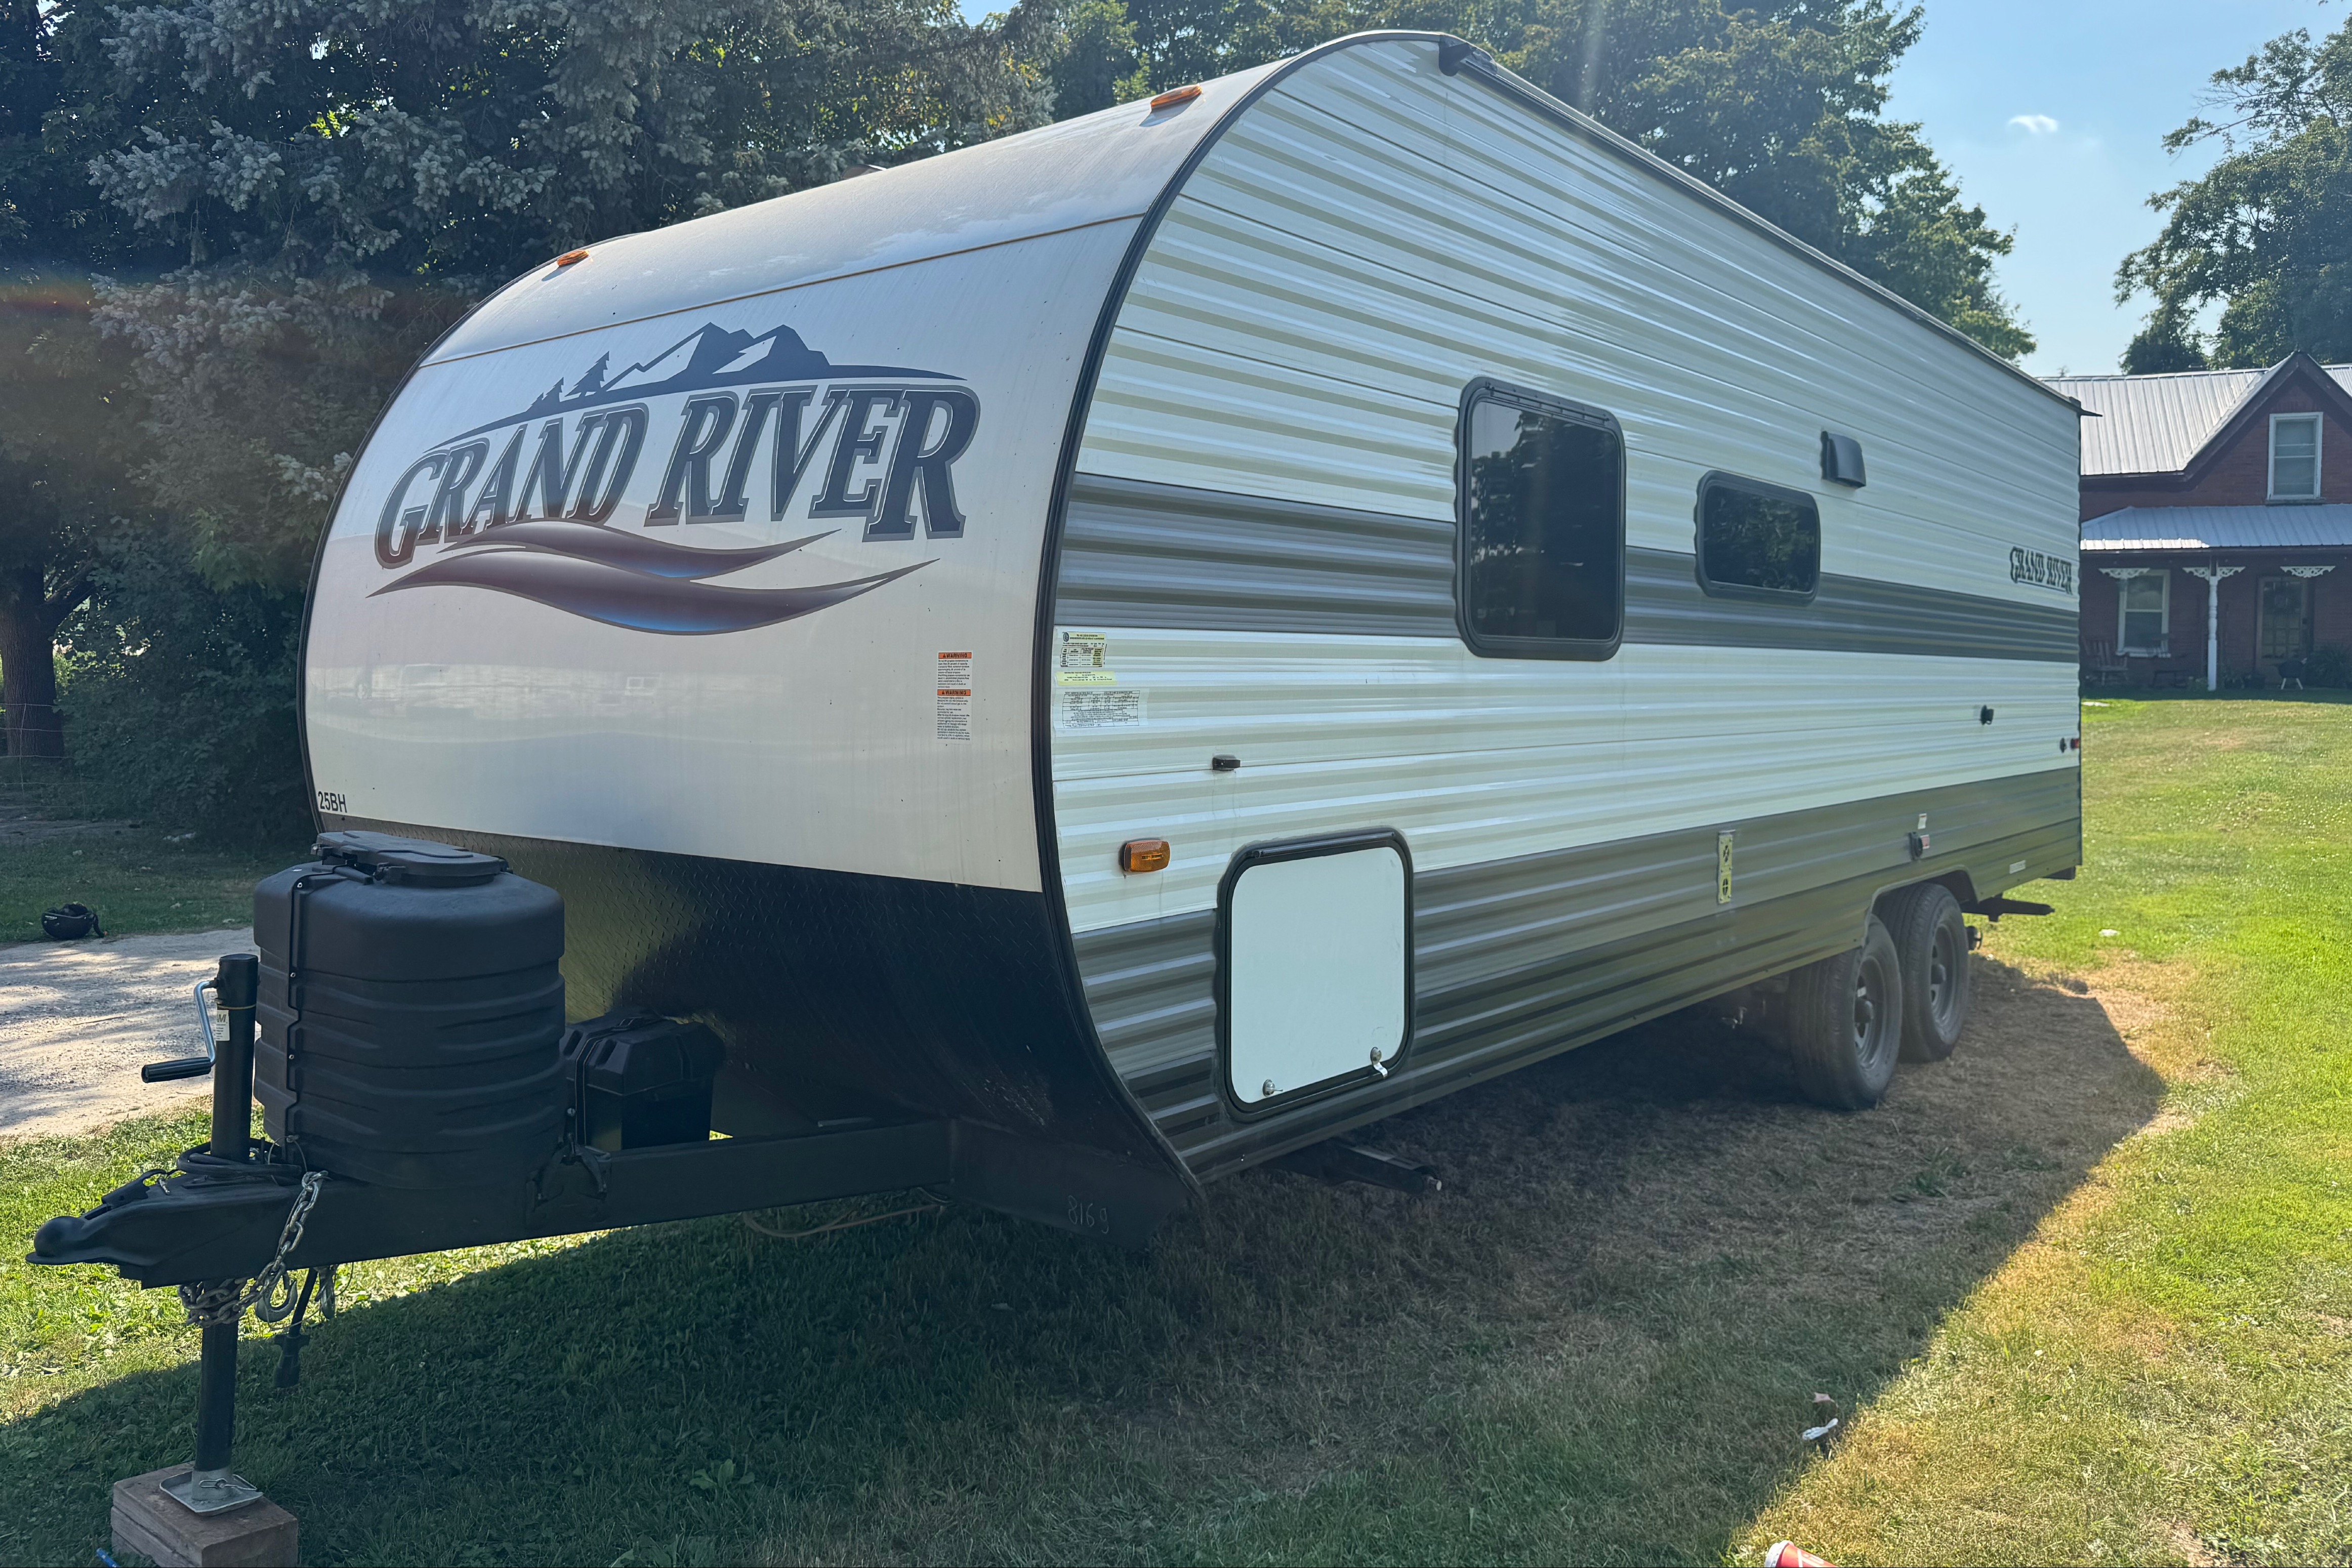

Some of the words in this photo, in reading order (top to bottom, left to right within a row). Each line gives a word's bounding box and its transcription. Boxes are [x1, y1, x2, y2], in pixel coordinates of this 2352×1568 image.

[374, 403, 649, 569] GRAND
[644, 383, 981, 542] RIVER
[2010, 546, 2045, 583] GRAND
[2046, 555, 2073, 595] RIVER
[318, 791, 347, 813] 25BH
